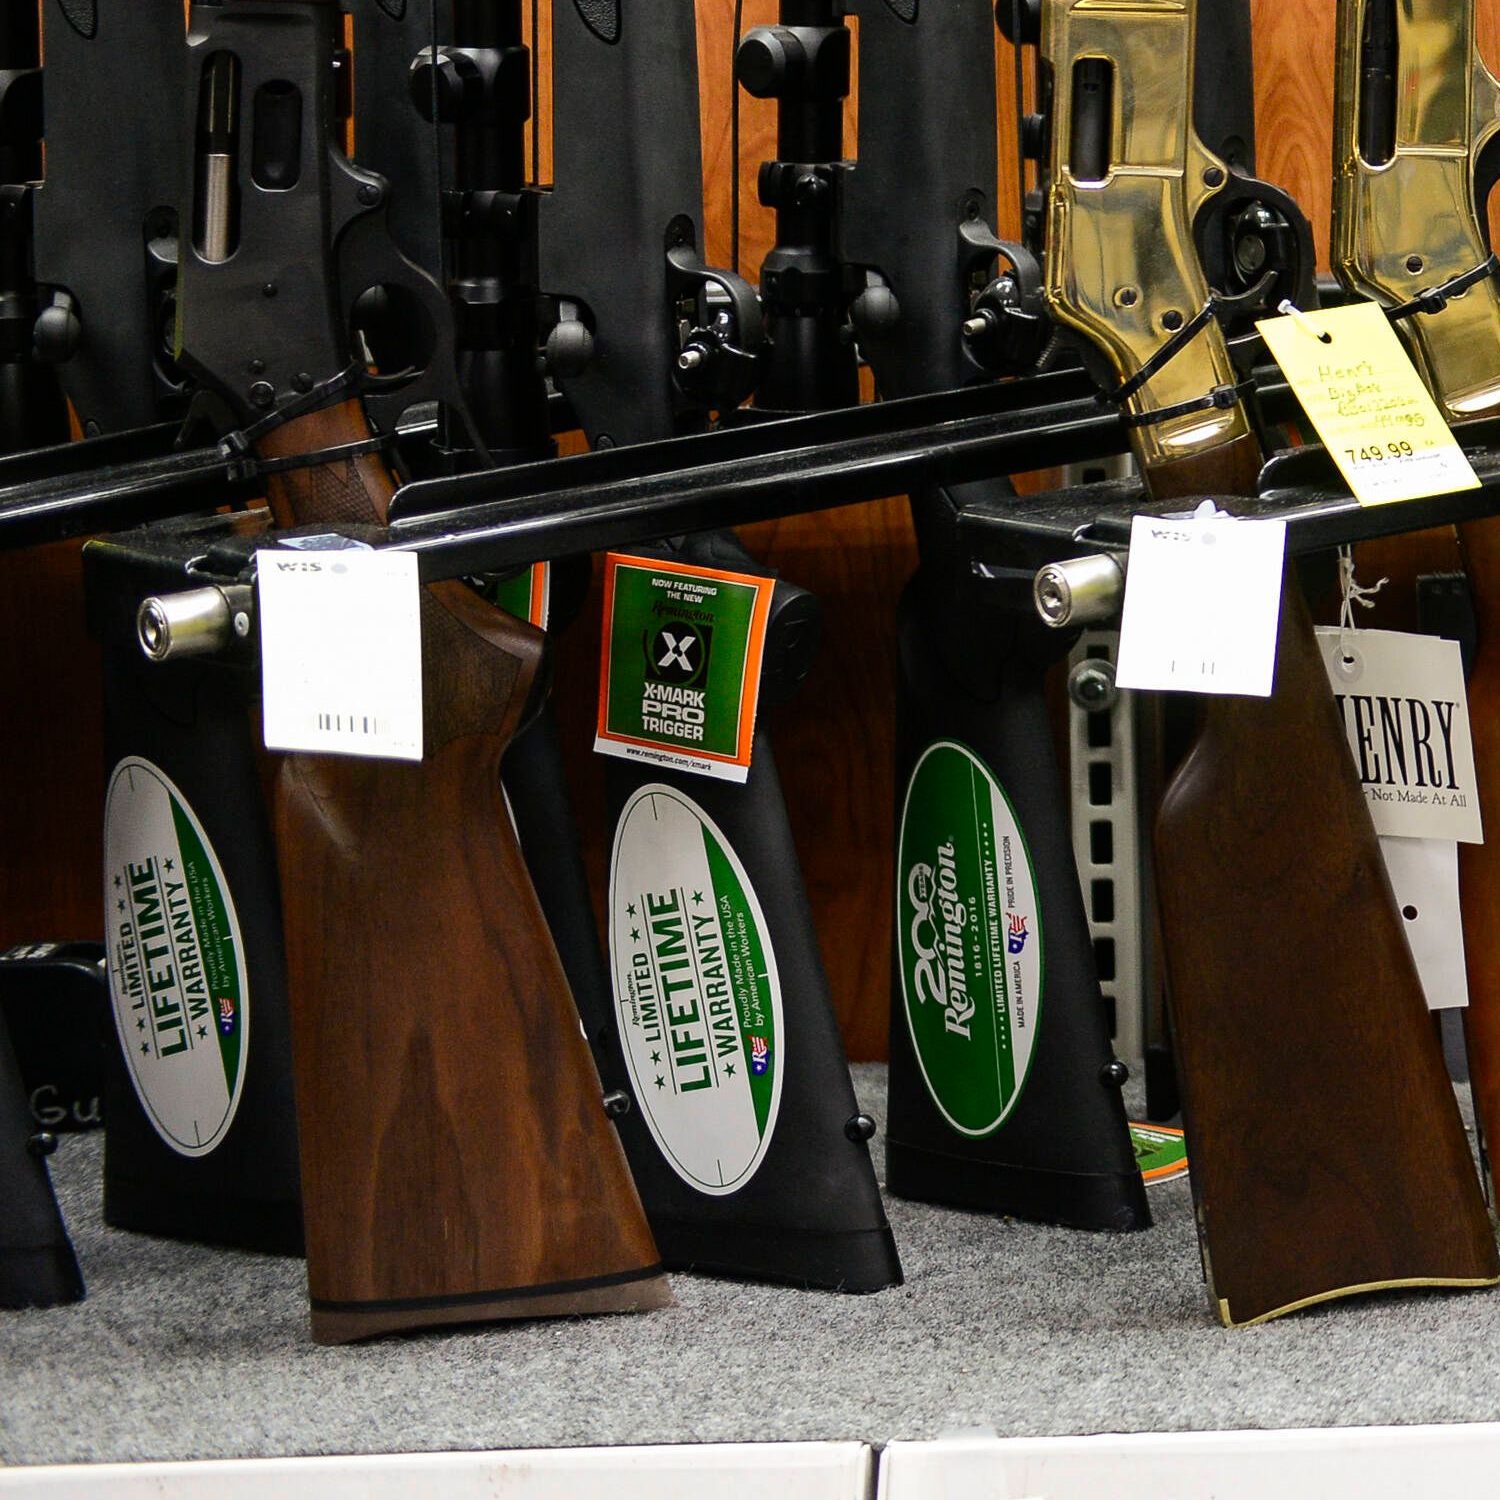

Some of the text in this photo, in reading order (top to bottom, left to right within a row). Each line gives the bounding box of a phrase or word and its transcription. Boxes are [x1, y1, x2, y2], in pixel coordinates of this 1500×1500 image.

[1345, 440, 1413, 465] 749.99
[652, 578, 718, 596] NOW FEATURING
[667, 590, 704, 604] THE NEW
[641, 699, 705, 724] PRO
[643, 682, 705, 708] X-MARK
[642, 715, 704, 741] TRIGGER
[626, 747, 712, 771] www.remington.com/xmark
[1371, 788, 1466, 807] Not Made At All
[1003, 835, 1012, 874] PRECISION
[719, 895, 733, 919] USA
[1007, 885, 1016, 909] PRIDE
[727, 921, 736, 939] the
[937, 840, 976, 1042] Remington
[985, 859, 1006, 1013] LIMITED LIFETIME WARRANTY
[128, 857, 188, 1058] LIFETIME
[164, 881, 209, 1021] WARRANTY
[209, 923, 226, 975] American
[120, 922, 146, 1010] LIMITED
[731, 956, 744, 986] Made
[738, 912, 764, 1026] by American Workers
[1013, 961, 1023, 994] AMERICA
[632, 953, 661, 1042] LIMITED
[647, 888, 713, 1093] LIFETIME
[692, 914, 739, 1058] WARRANTY
[736, 988, 752, 1028] Proudly
